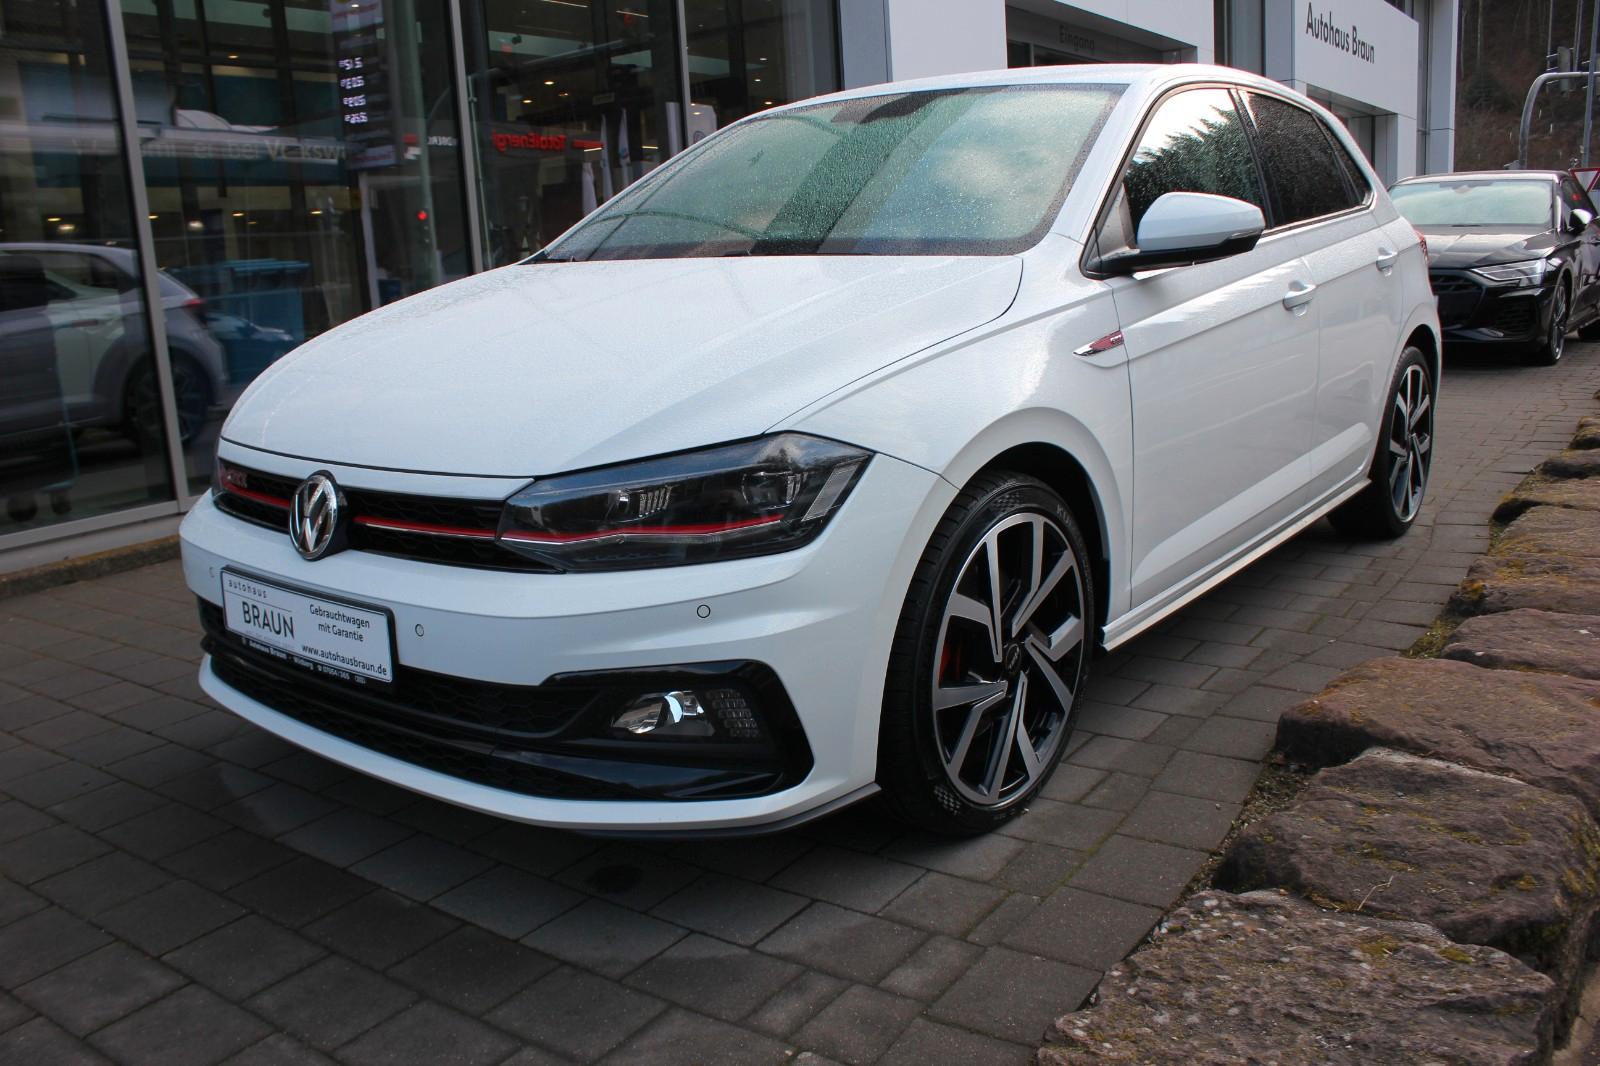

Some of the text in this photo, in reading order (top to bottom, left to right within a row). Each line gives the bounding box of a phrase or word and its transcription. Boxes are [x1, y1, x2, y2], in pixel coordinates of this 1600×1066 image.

[1306, 2, 1375, 64] Autohaus Braun
[228, 579, 267, 599] autohaus
[243, 601, 294, 638] BRAUN
[310, 604, 370, 627] Gebrauchtwagen
[317, 620, 363, 642] mit Garantie
[303, 645, 388, 675] www.autohausbraun.de
